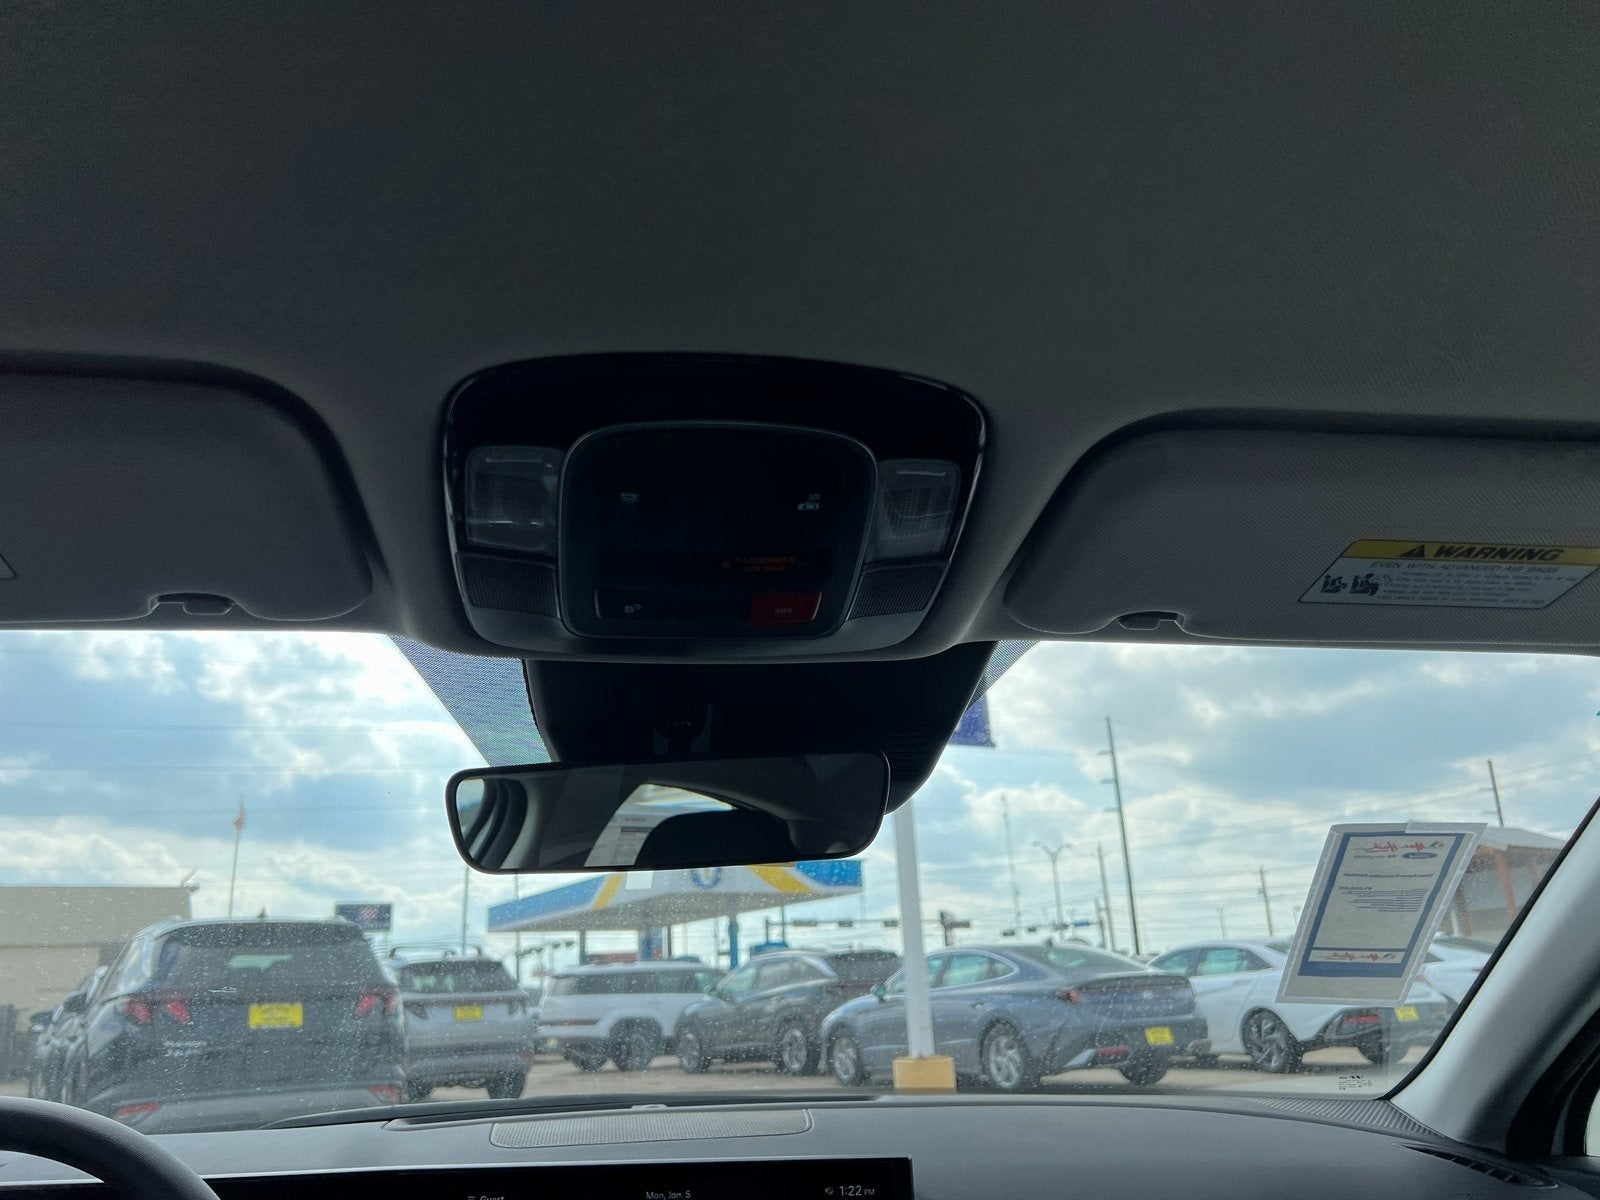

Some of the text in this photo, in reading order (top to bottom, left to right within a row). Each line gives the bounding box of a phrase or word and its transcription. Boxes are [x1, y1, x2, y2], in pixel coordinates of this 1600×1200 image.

[1434, 545, 1564, 561] WARNING
[1440, 563, 1501, 571] ADVANCED
[774, 607, 793, 615] SOS
[645, 1191, 666, 1200] Mon,
[685, 1190, 691, 1198] 5
[839, 1185, 863, 1196] 1:22
